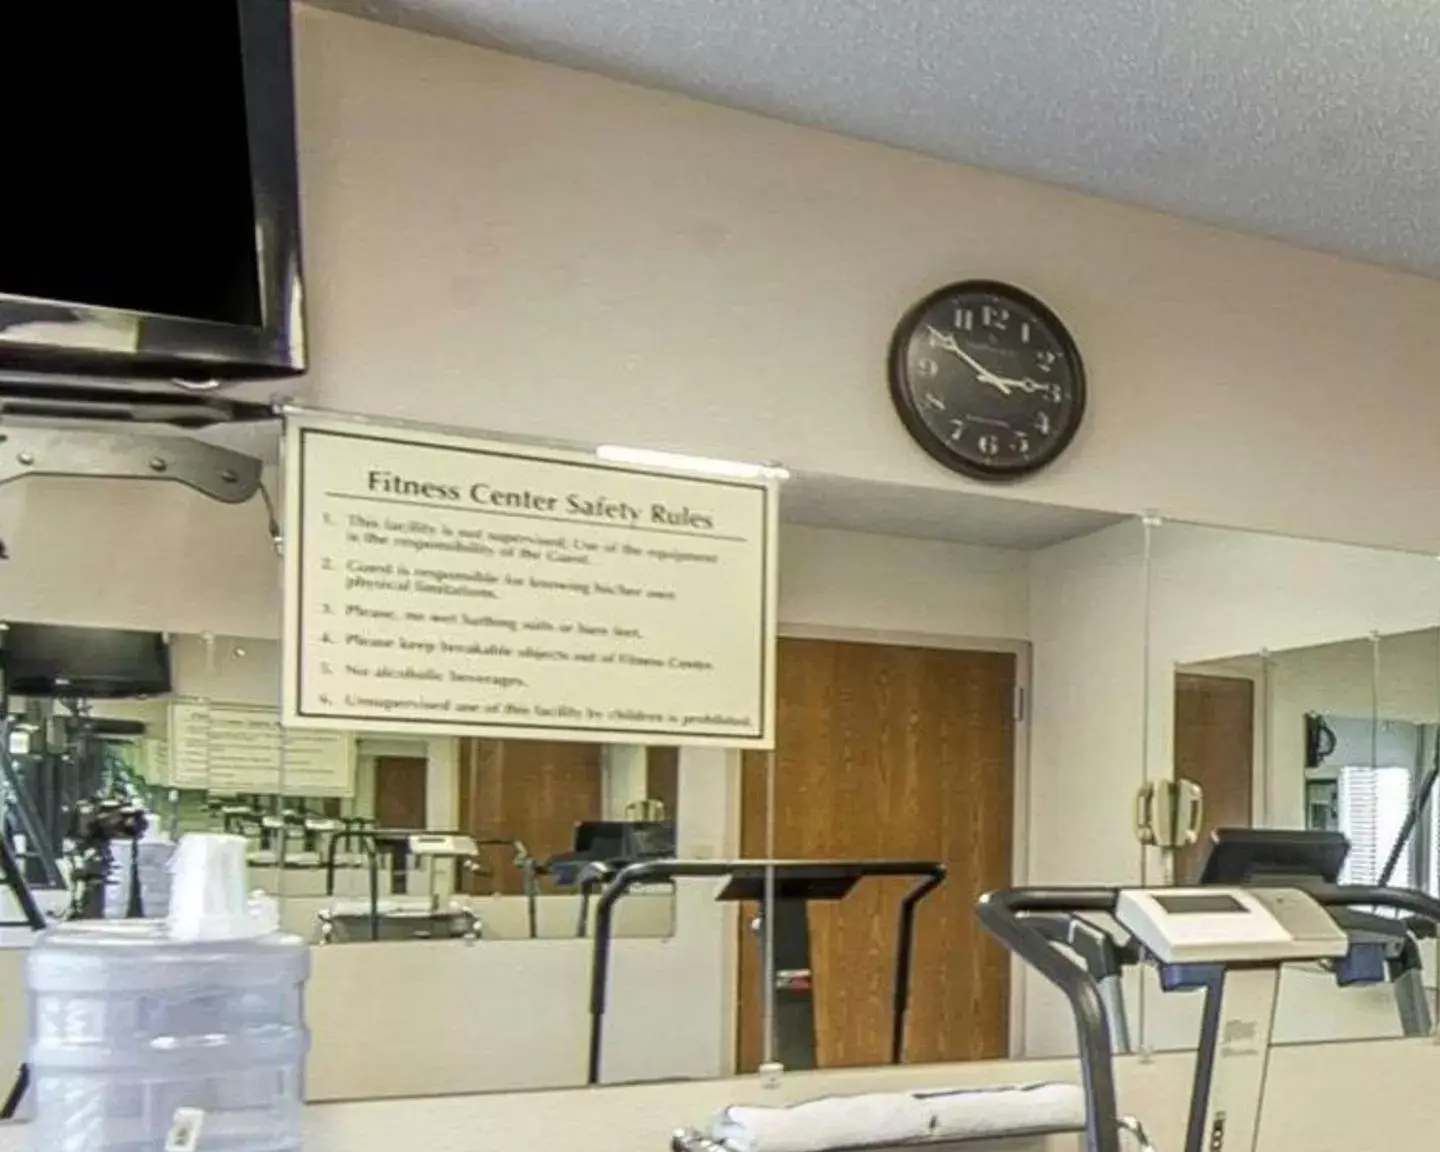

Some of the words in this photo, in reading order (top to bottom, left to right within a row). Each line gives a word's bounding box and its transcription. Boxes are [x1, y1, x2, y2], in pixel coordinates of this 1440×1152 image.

[955, 308, 973, 331] 11
[983, 305, 1010, 330] 12
[368, 470, 461, 500] Fitness
[469, 482, 557, 511] Center
[565, 493, 642, 525] Safety
[650, 503, 714, 529] Rules
[646, 548, 719, 564] equipment
[345, 575, 411, 594] physical
[528, 576, 591, 596] knowing
[461, 612, 518, 632] bathing
[345, 633, 395, 648] Please
[398, 636, 436, 655] keep
[440, 640, 512, 657] breakable
[618, 652, 665, 668] Fitness
[345, 664, 369, 677] No
[374, 664, 445, 682] alcoholic
[607, 708, 664, 724] children
